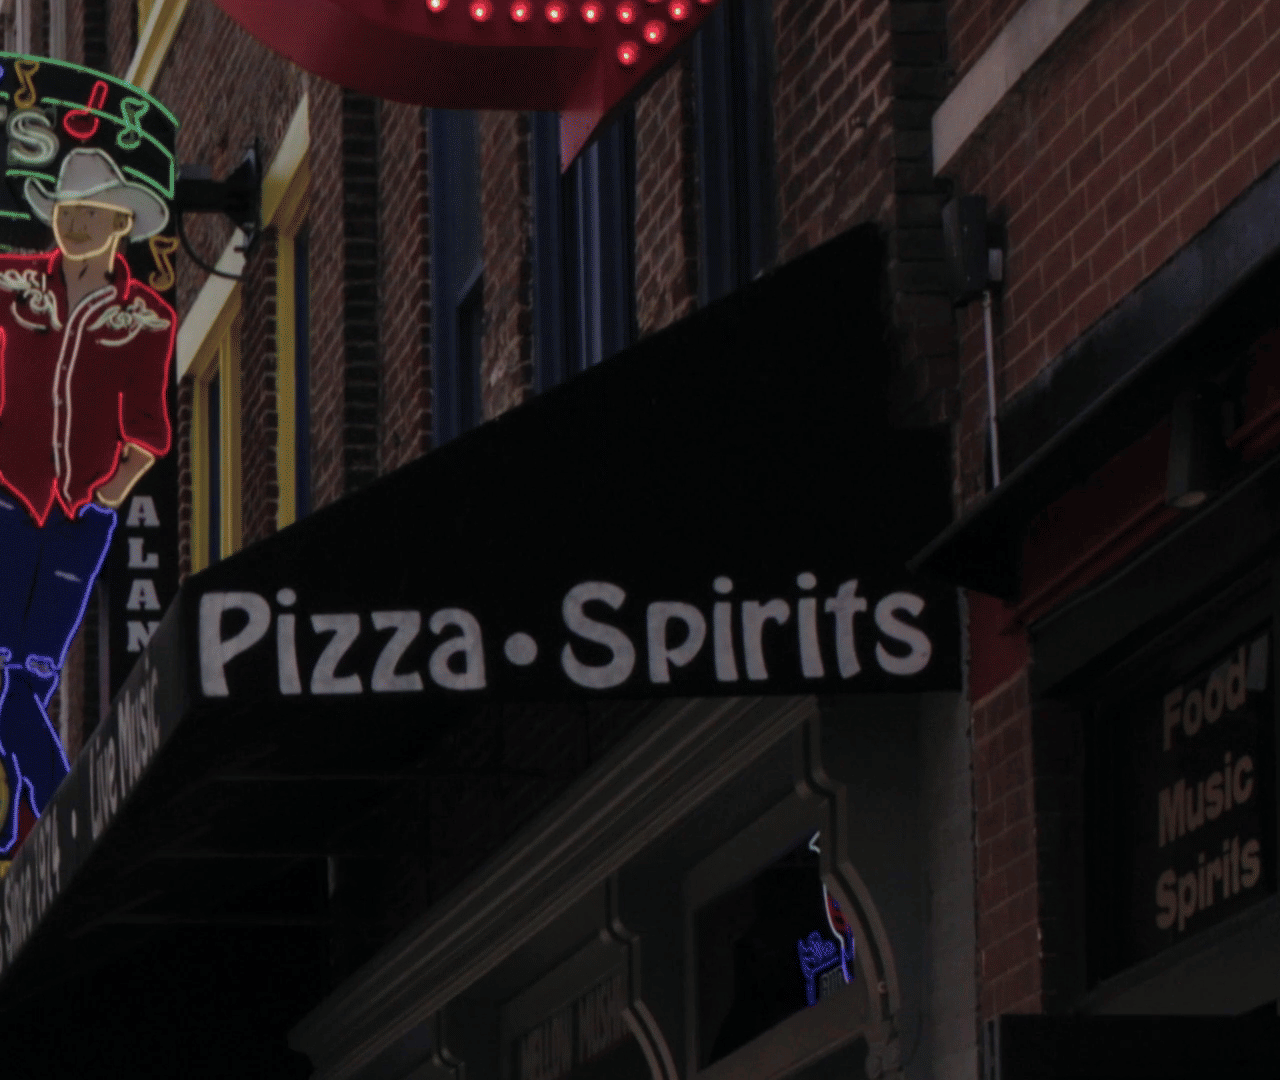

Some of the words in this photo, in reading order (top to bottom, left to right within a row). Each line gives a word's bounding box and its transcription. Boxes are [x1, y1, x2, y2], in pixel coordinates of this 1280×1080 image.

[199, 589, 487, 696] Pizza
[559, 571, 933, 691] Spirits
[1162, 646, 1249, 751] Food
[1157, 752, 1255, 848] Music
[1155, 838, 1262, 931] Spirits
